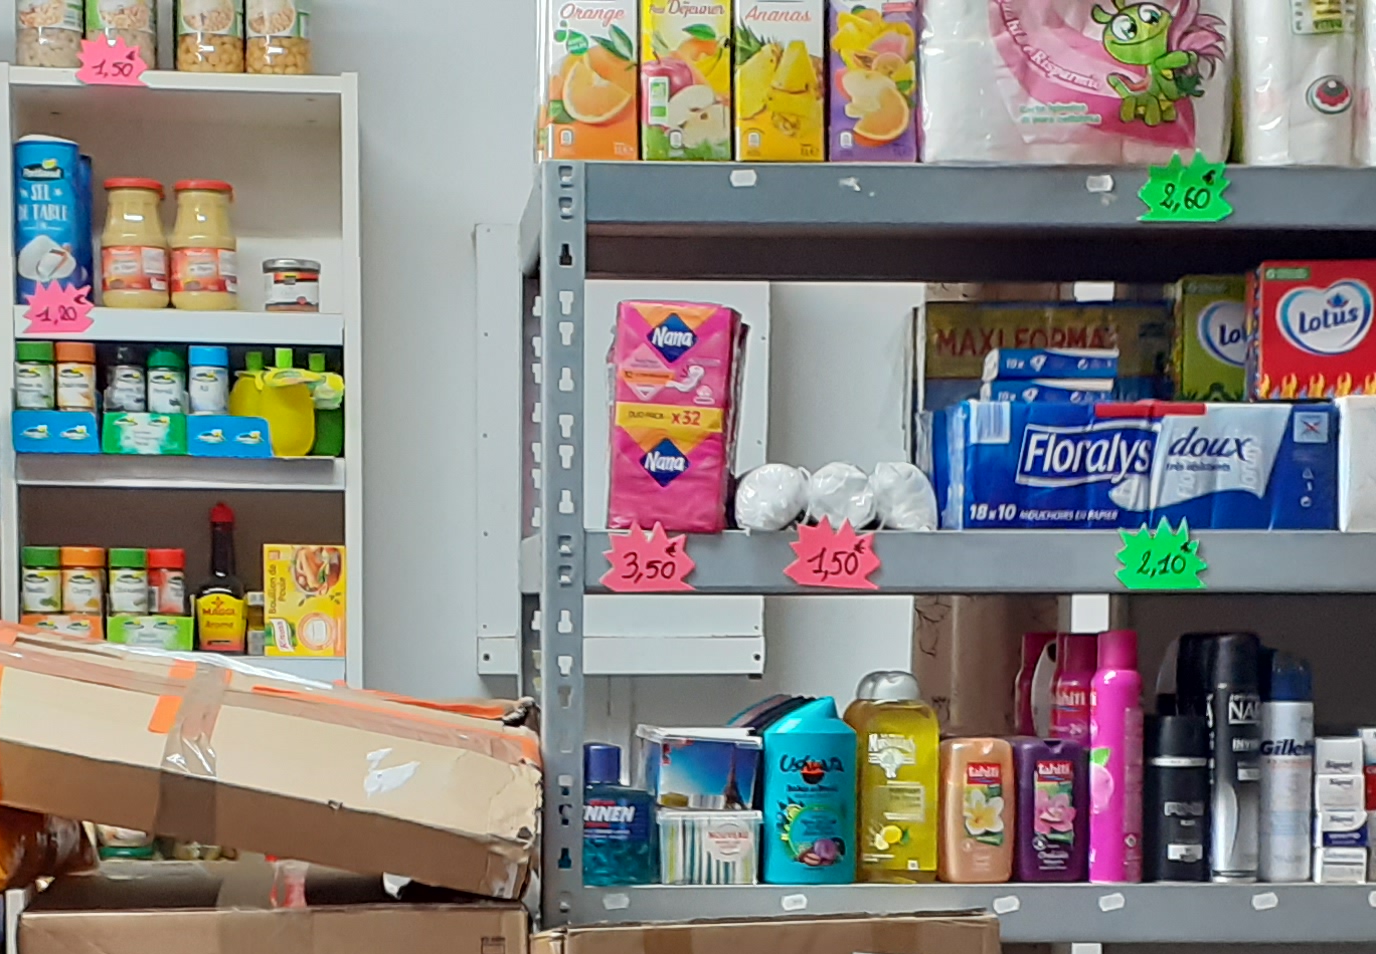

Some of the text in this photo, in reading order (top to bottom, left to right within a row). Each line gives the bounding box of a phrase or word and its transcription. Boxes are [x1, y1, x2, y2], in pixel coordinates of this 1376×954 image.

[560, 3, 624, 27] Orange
[745, 7, 812, 22] Ananas
[1299, 306, 1359, 335] Lotus
[652, 326, 694, 348] Nana
[1168, 427, 1250, 461] doux
[643, 451, 686, 472] Nana
[1024, 432, 1151, 481] Floralys
[584, 806, 635, 822] NNEN
